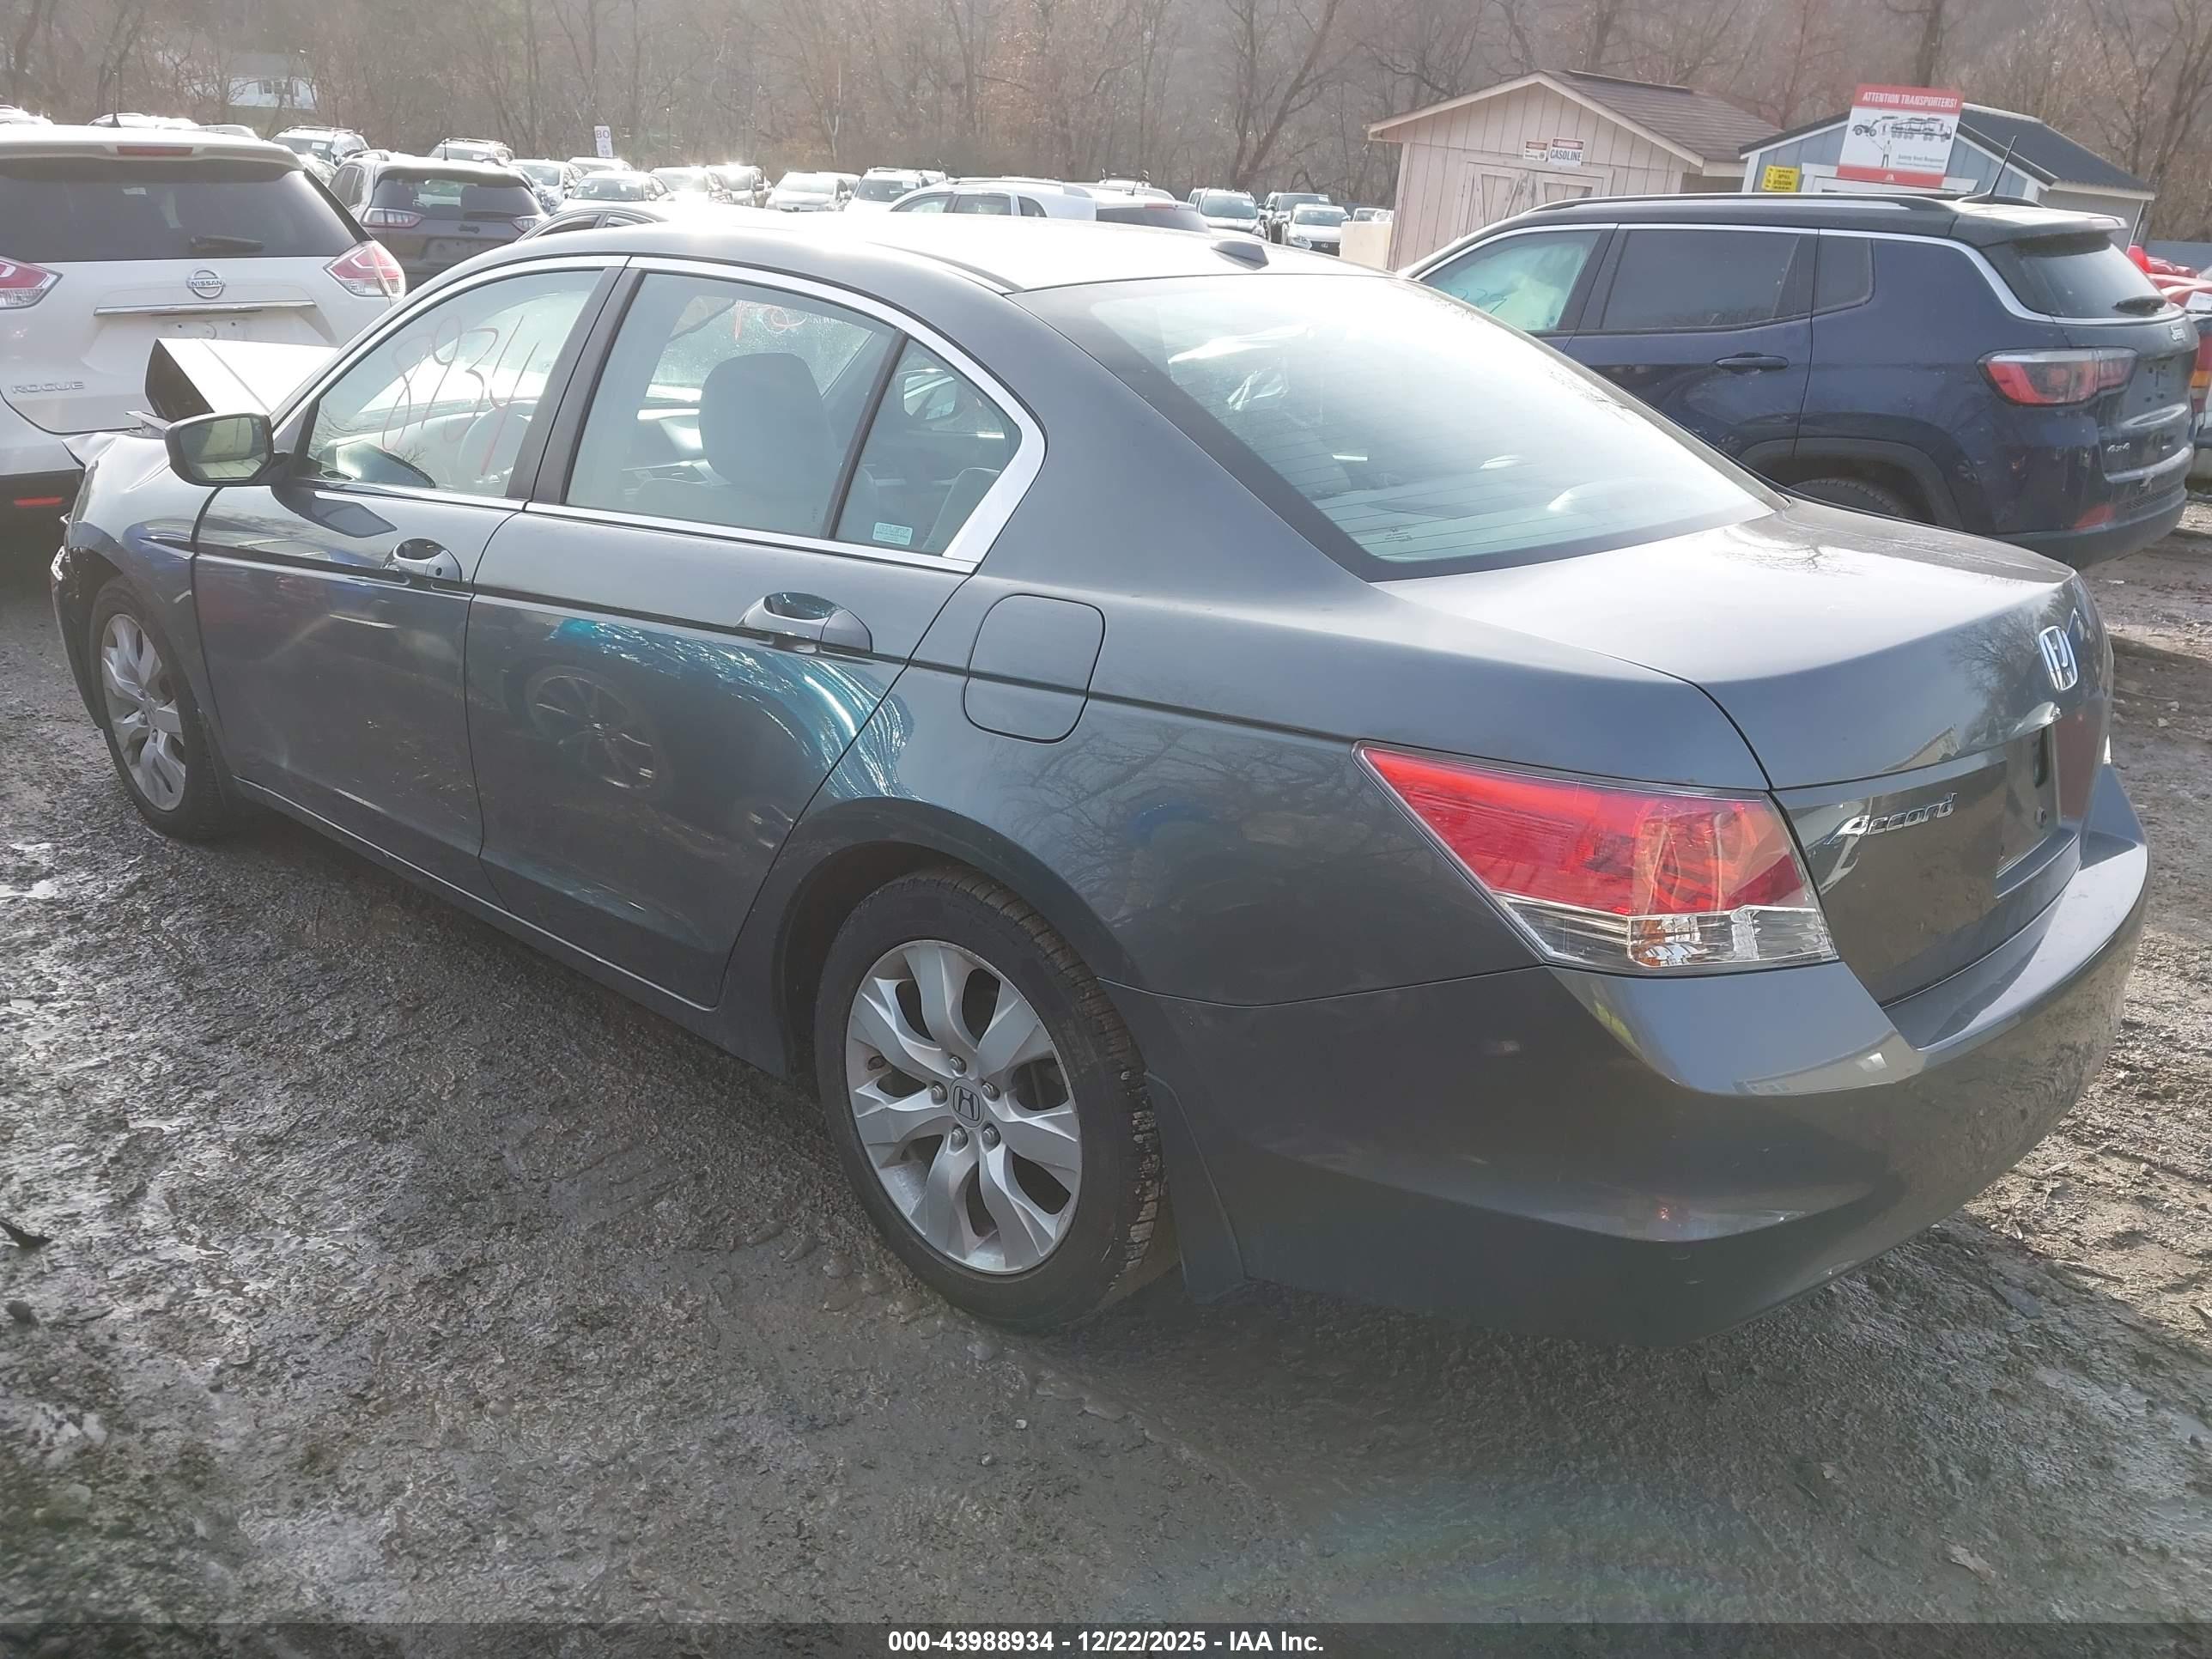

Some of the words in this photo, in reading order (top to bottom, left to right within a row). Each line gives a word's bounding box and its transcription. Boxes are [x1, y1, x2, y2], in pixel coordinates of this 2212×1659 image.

[1862, 91, 1900, 104] ATTENTION
[1900, 94, 1958, 109] TRANSPORTERS!
[1550, 149, 1582, 161] GASOLINE
[12, 381, 84, 395] ROGUE
[1822, 792, 1958, 846] Accord
